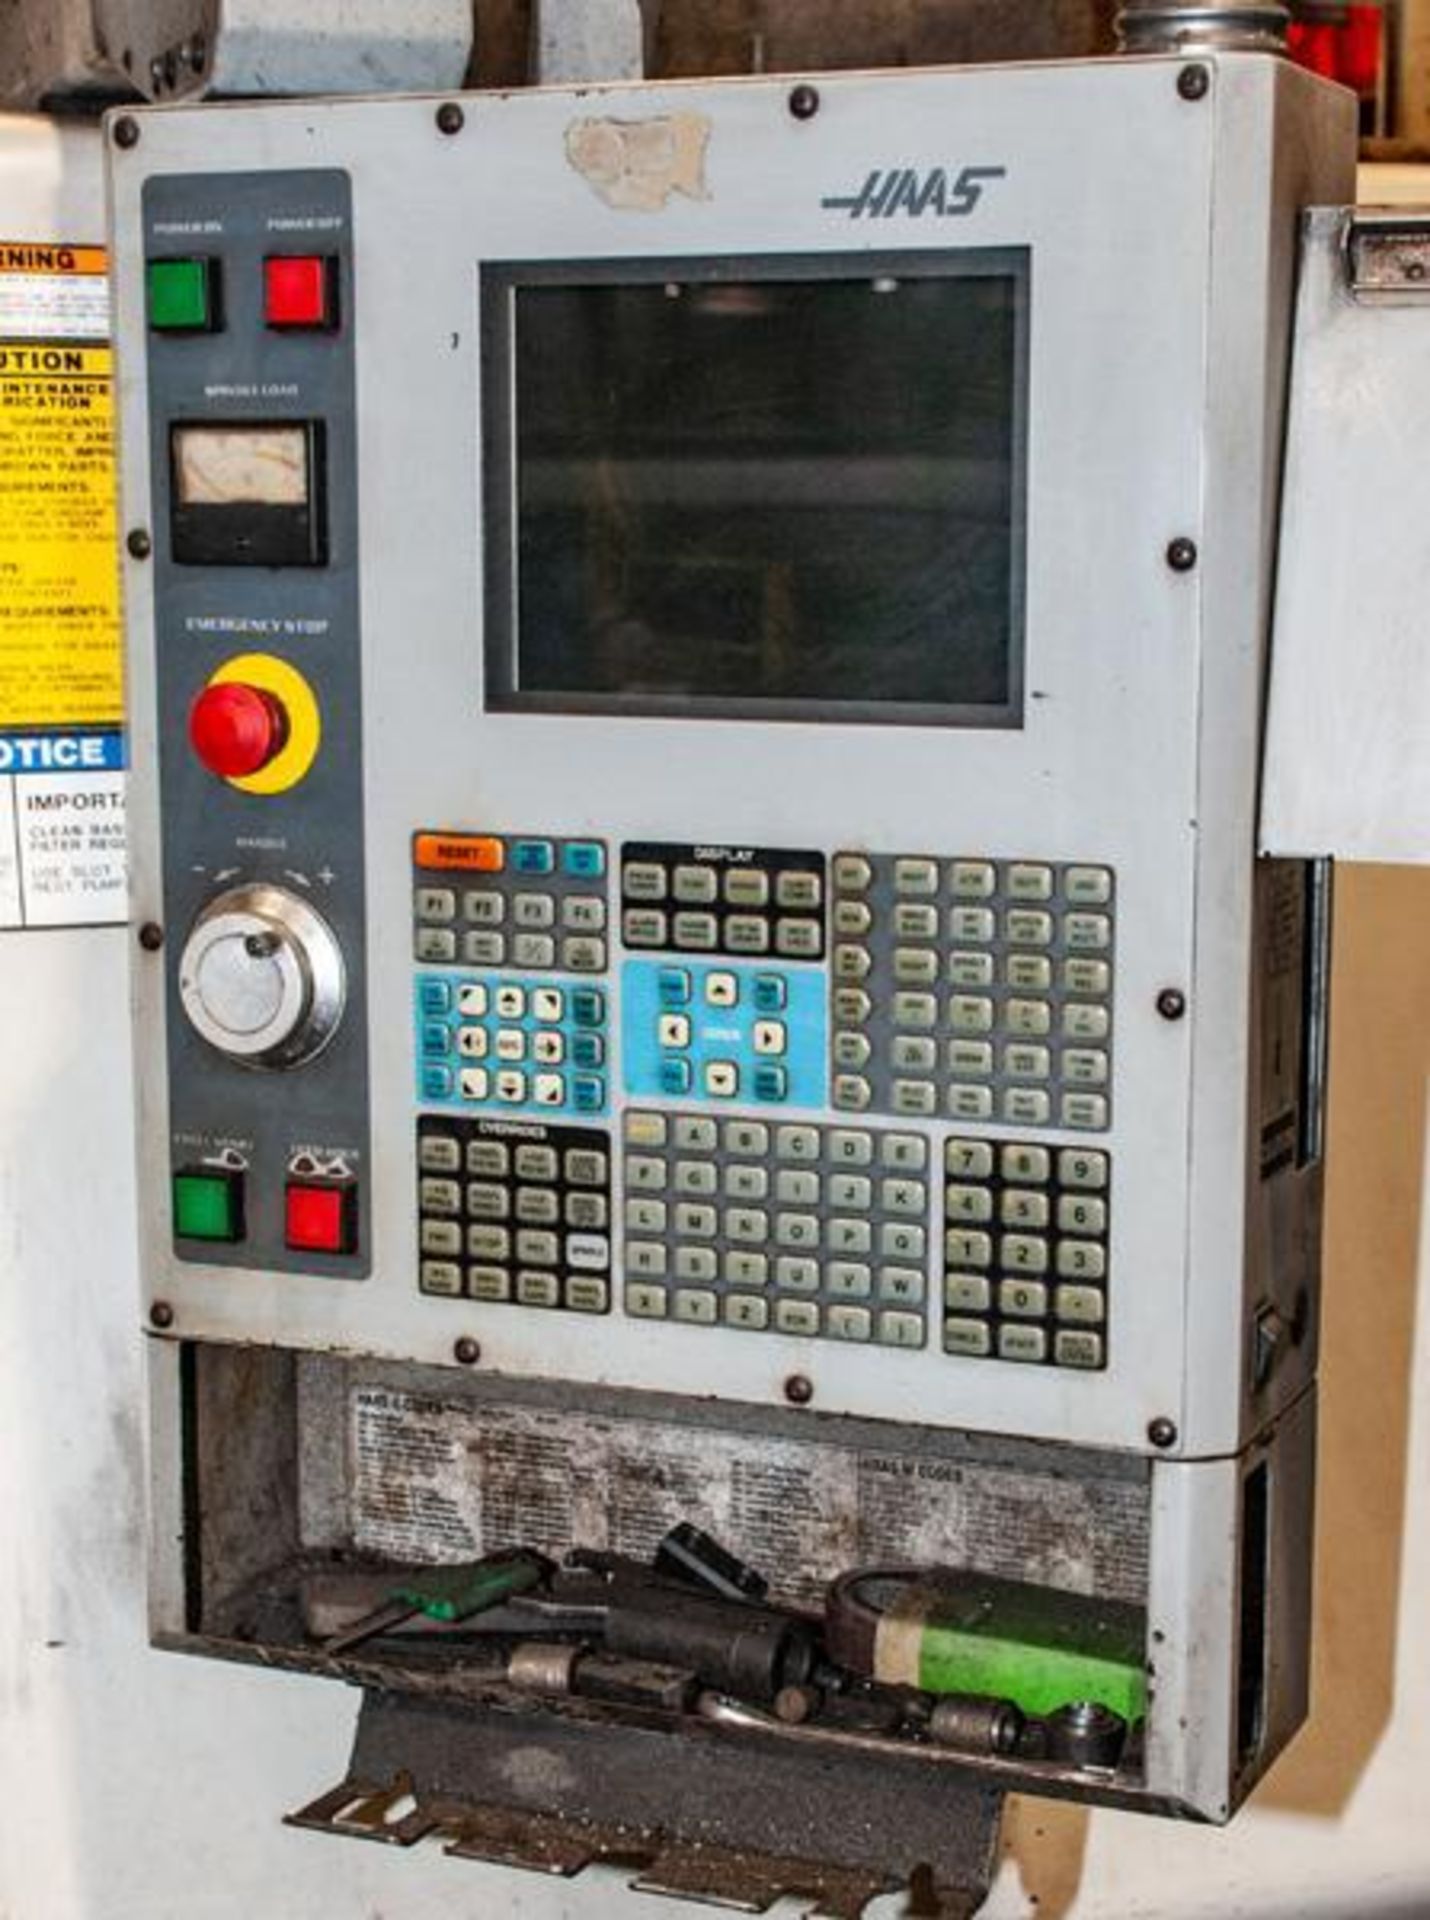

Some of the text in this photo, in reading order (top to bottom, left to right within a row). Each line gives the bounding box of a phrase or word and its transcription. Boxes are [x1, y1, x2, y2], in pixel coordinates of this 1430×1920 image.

[822, 166, 1006, 218] HAAS
[0, 249, 76, 269] NING
[961, 1150, 974, 1167] 7
[1073, 1160, 1089, 1179] 9
[1073, 1205, 1087, 1224] 6
[963, 1241, 972, 1256] 1
[1016, 1244, 1029, 1263] 2
[1073, 1250, 1086, 1269] 3
[1013, 1289, 1029, 1309] 0
